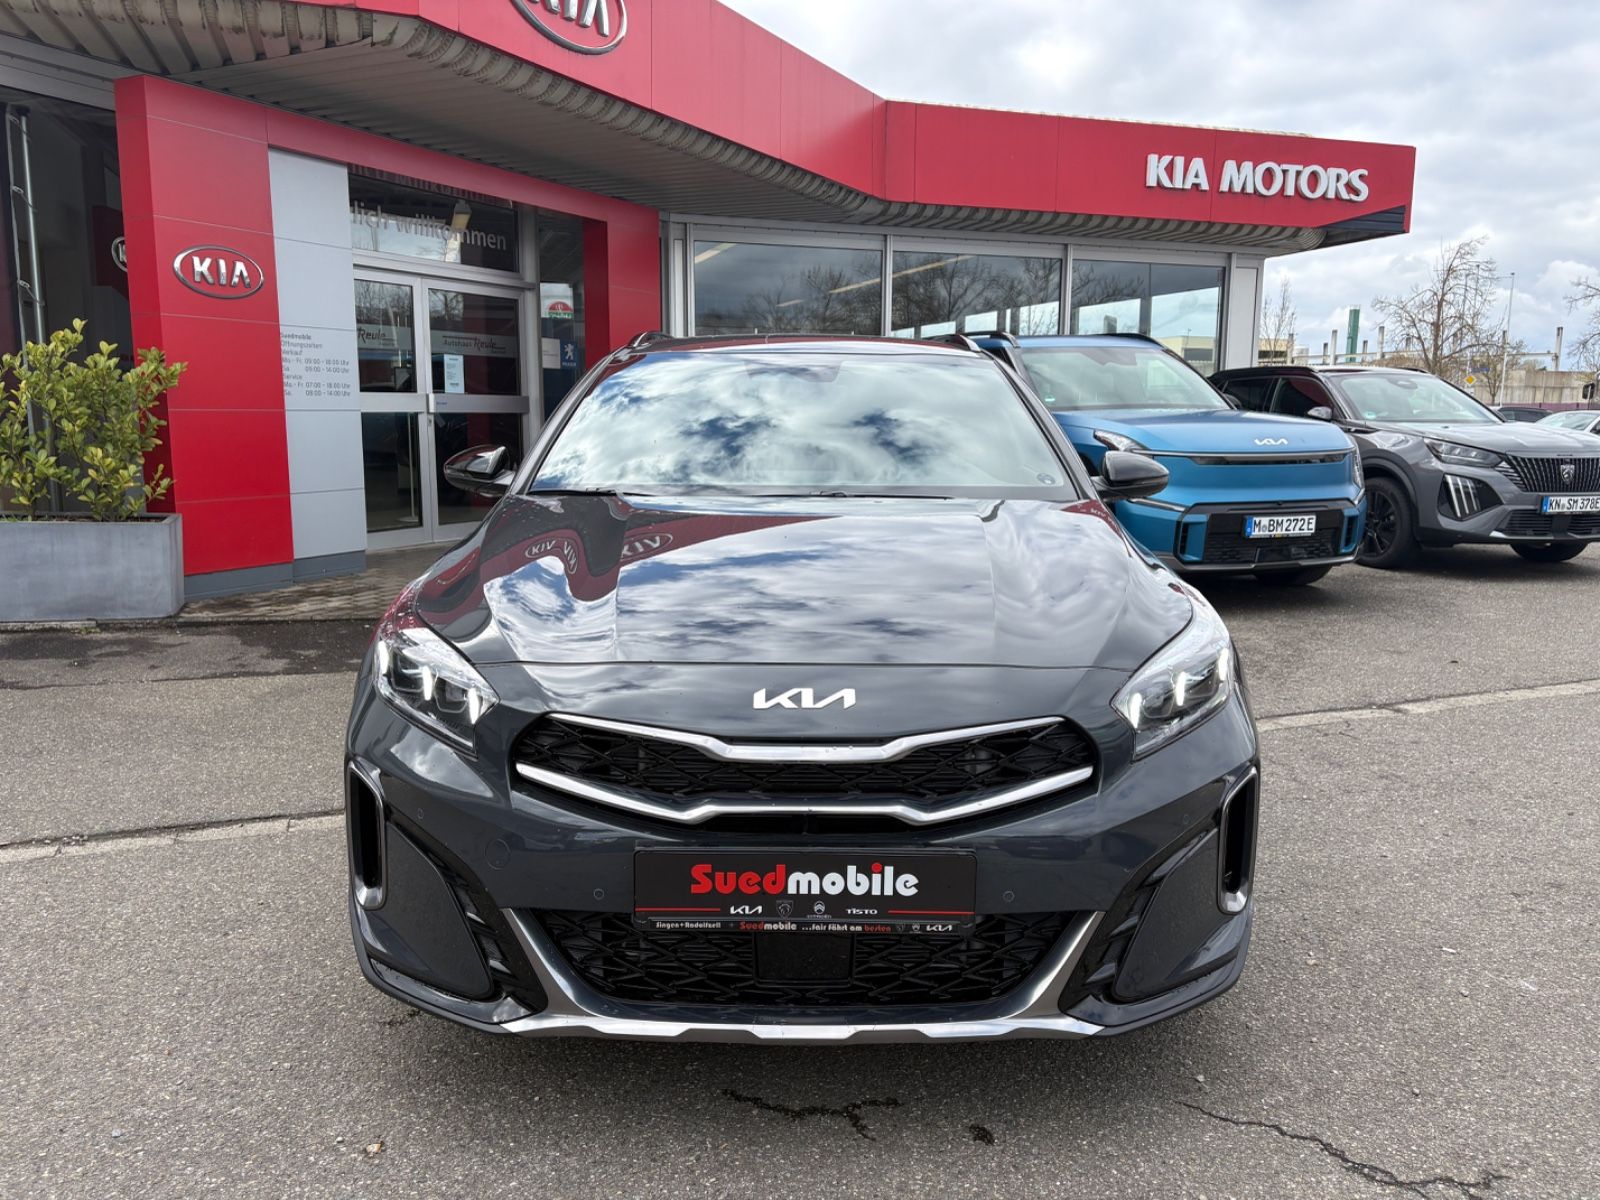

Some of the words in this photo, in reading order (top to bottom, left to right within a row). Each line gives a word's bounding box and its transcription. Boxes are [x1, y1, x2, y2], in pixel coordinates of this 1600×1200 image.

[1145, 153, 1210, 191] KIA
[1219, 159, 1369, 202] MOTORS
[395, 212, 507, 251] willkommen
[192, 255, 252, 289] KIA
[752, 687, 857, 710] KIA
[690, 862, 919, 897] Suedmobile
[729, 905, 763, 915] KIA
[738, 920, 798, 931] Suedmobile
[926, 923, 953, 932] KIA
